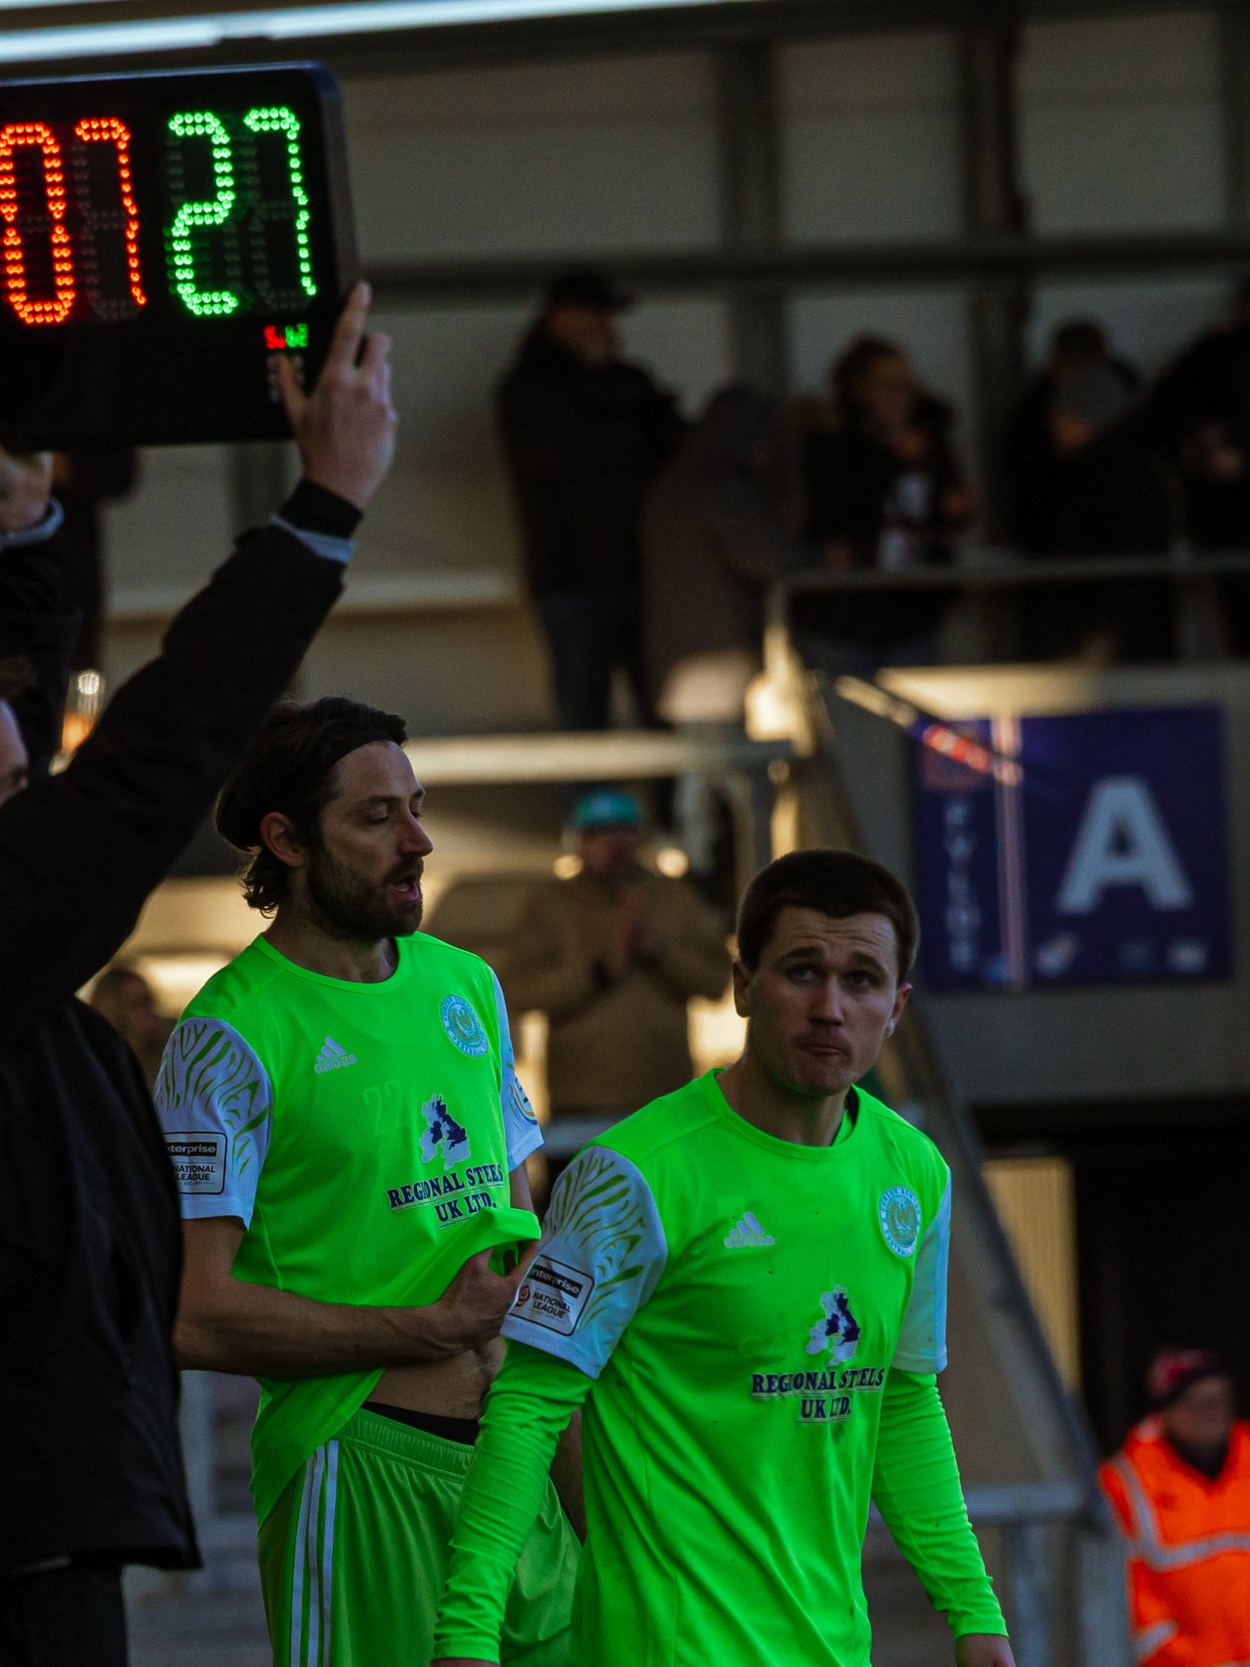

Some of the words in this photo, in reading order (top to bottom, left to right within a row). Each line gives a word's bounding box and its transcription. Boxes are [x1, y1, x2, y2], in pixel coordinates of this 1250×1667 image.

[169, 107, 317, 315] 27
[1056, 775, 1193, 913] A
[167, 1144, 216, 1155] nterprise
[387, 1172, 465, 1208] REGONAL
[434, 1199, 464, 1222] UK
[464, 1192, 497, 1214] LTD.
[533, 1268, 580, 1294] nterprise
[533, 1301, 566, 1319] LEAGUE
[751, 1371, 837, 1393] REGONAL
[838, 1367, 885, 1389] STELS
[800, 1399, 827, 1418] UK
